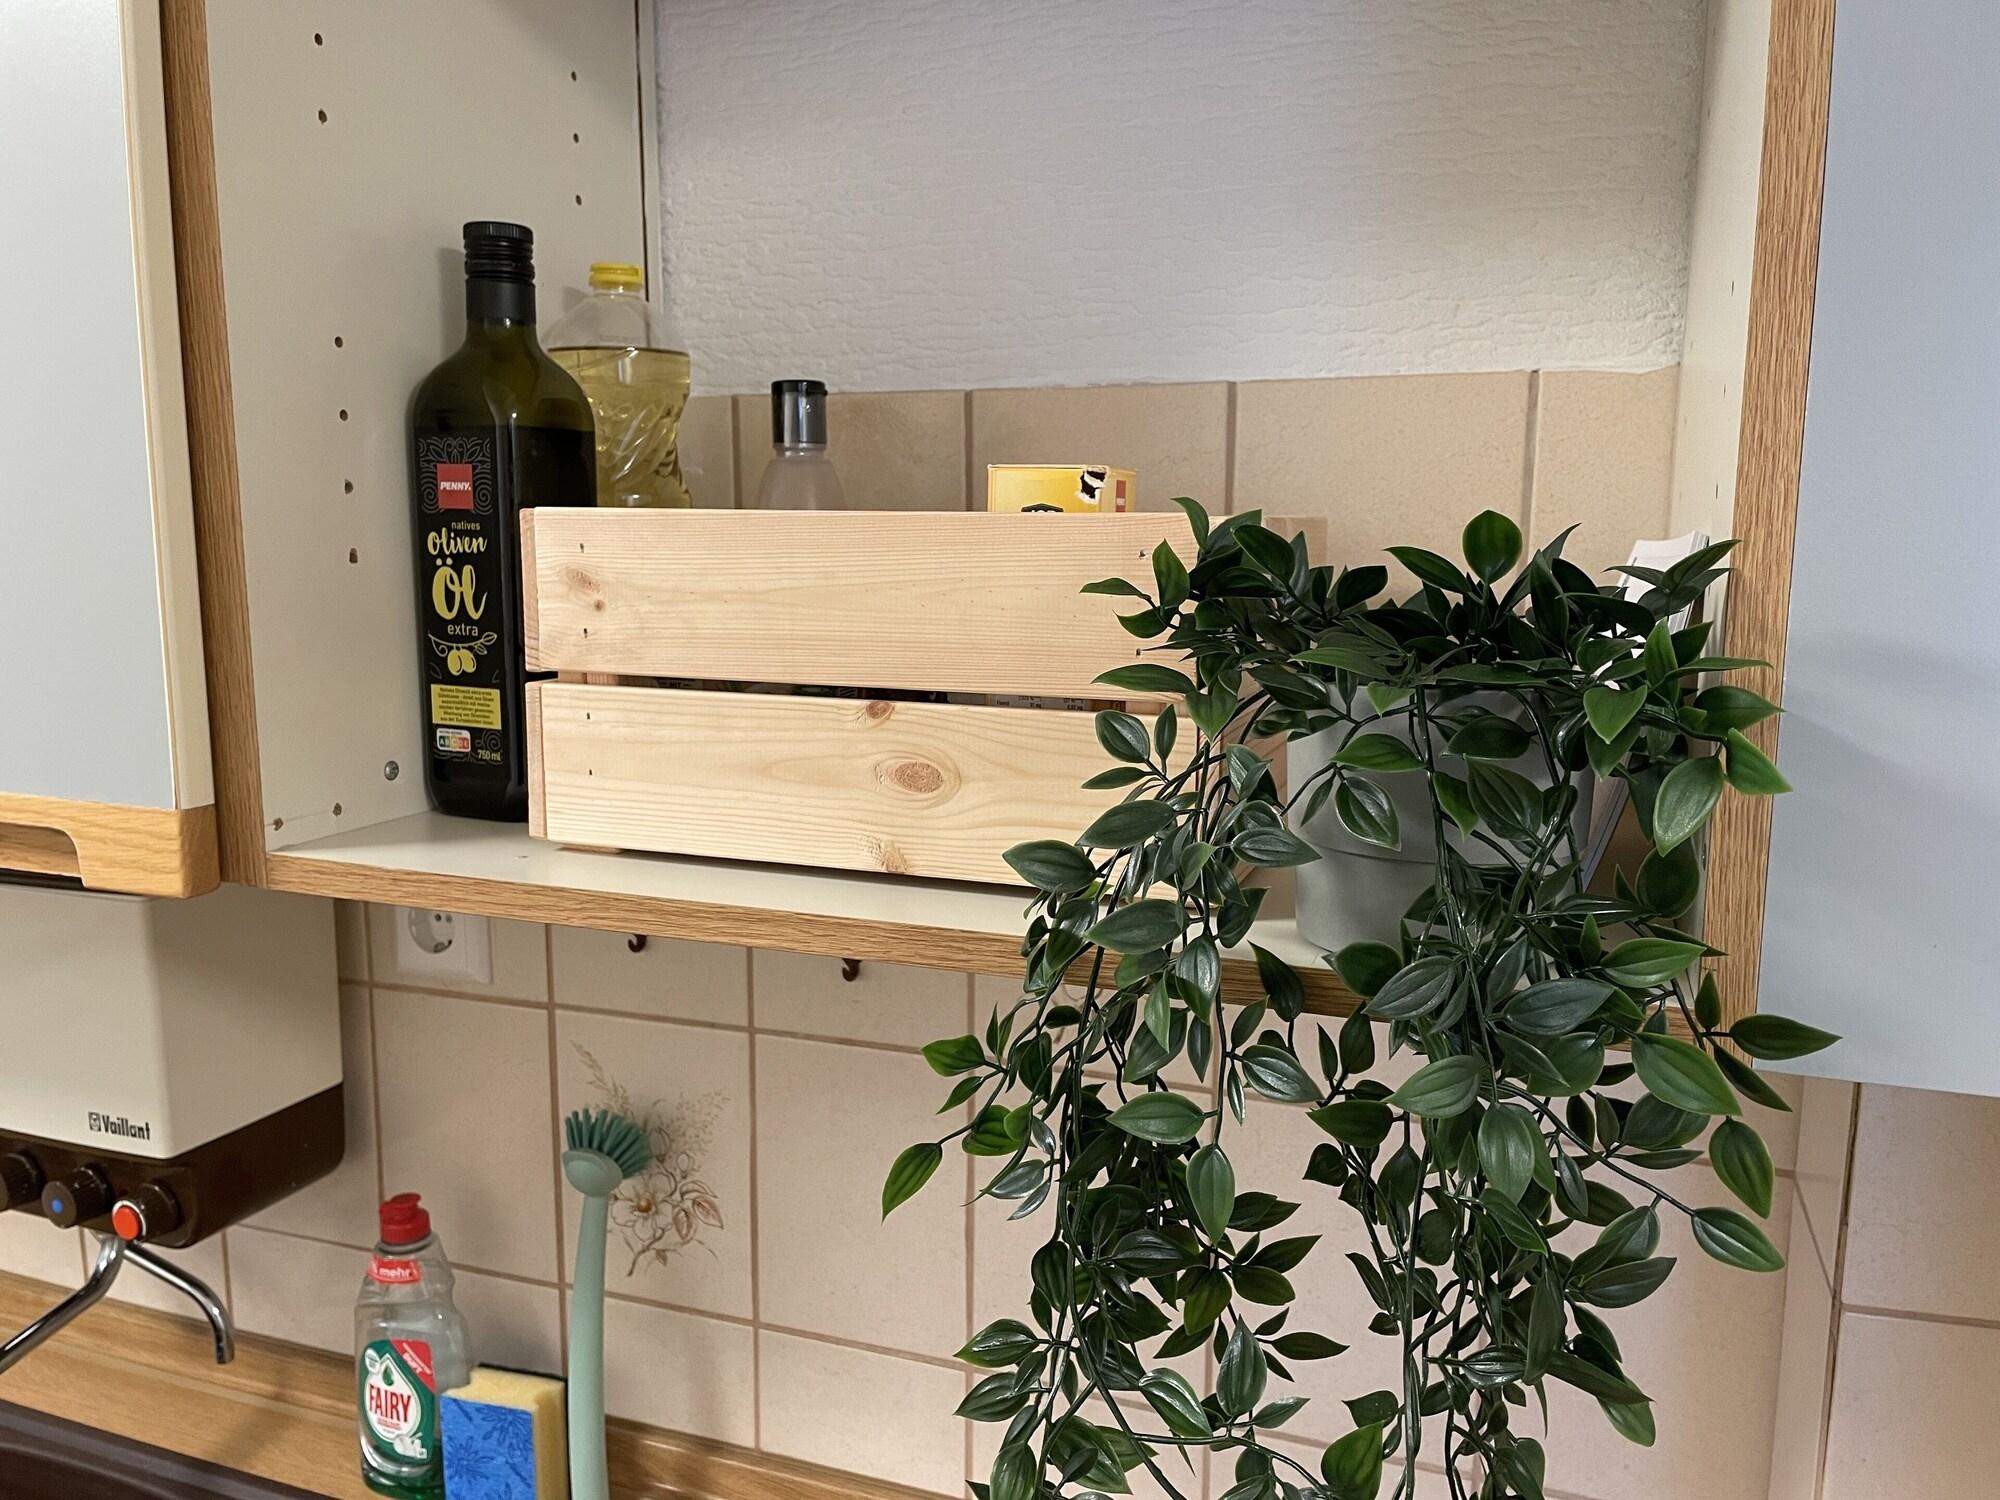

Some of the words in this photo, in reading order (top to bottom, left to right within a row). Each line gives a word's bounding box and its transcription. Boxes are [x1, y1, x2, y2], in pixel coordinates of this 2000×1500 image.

[451, 520, 481, 531] natives
[432, 556, 488, 620] Öl
[447, 623, 479, 637] extra
[102, 1114, 151, 1141] Vaillant
[369, 1383, 412, 1423] FAIRY
